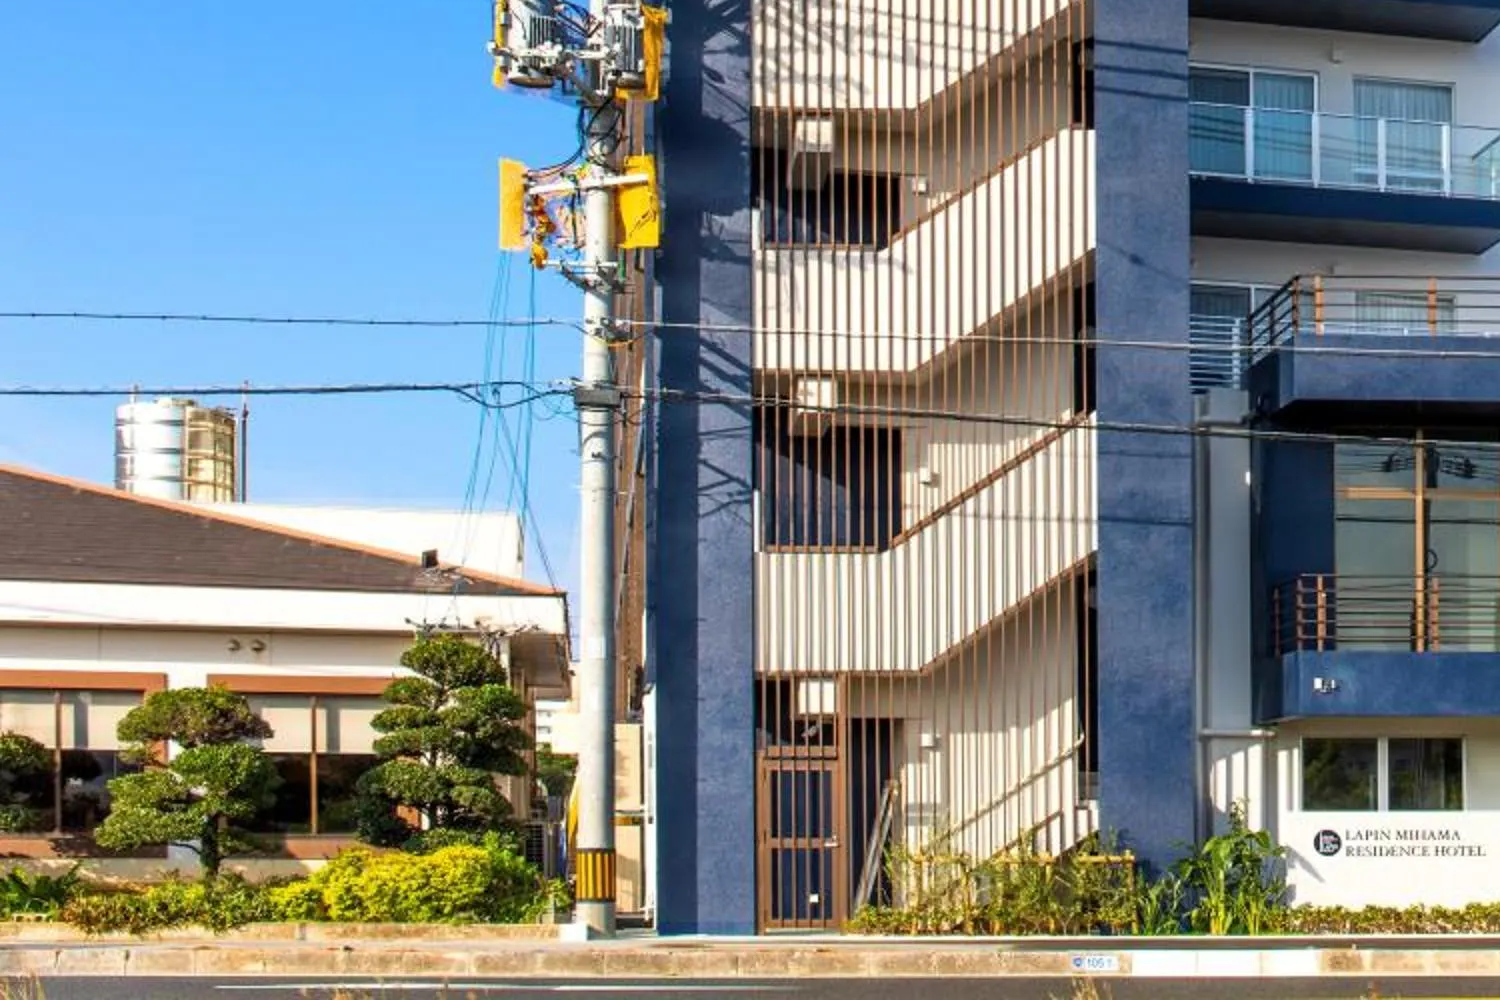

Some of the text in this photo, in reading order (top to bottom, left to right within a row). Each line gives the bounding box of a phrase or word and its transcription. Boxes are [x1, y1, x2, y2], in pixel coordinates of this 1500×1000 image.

[1345, 829, 1461, 841] LAPIN MIHAMA
[1345, 845, 1487, 857] RESIDENCE HOTEL
